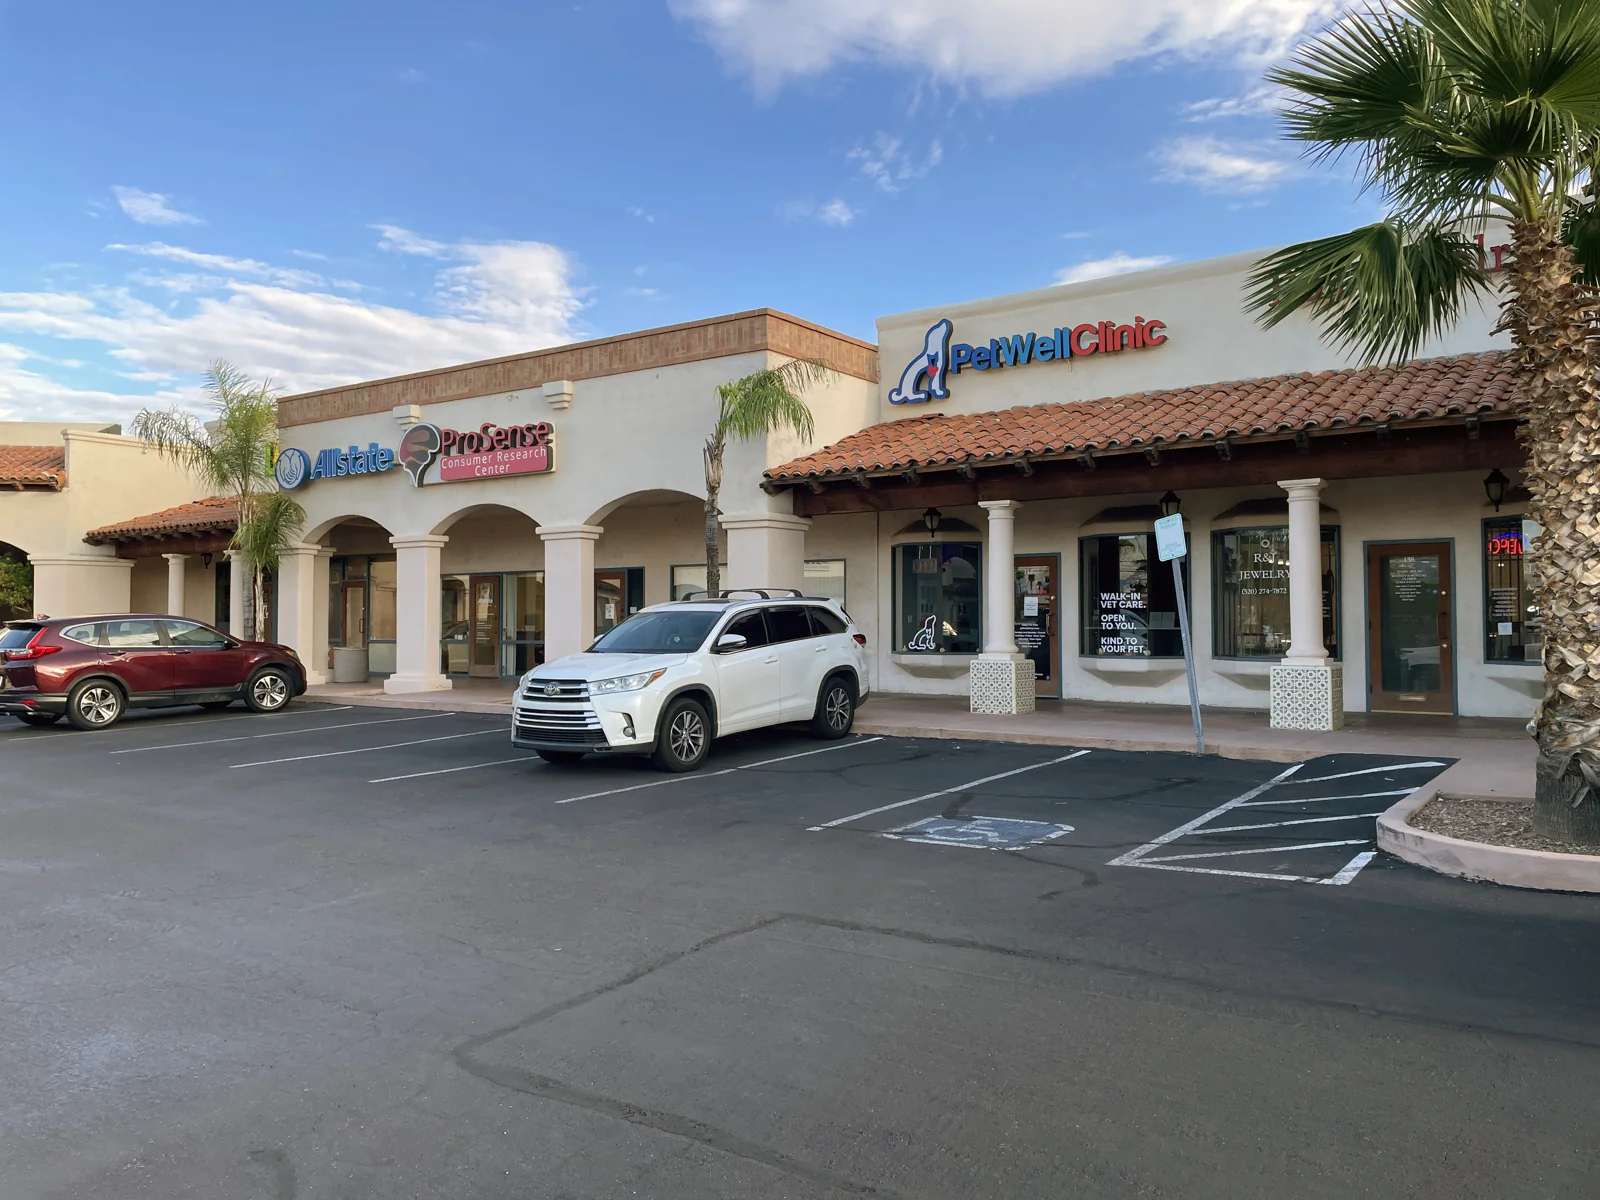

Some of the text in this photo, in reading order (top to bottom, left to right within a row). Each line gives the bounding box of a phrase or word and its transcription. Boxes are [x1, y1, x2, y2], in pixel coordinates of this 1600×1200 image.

[951, 316, 1168, 374] PetWellClinic
[441, 421, 552, 456] ProSense
[310, 443, 394, 479] Allstate
[441, 447, 547, 469] Consumer Research
[475, 463, 511, 477] Center
[1487, 538, 1523, 554] OPEN
[1253, 553, 1275, 563] R&J
[1239, 570, 1290, 580] JEWELRY
[1100, 592, 1141, 600] WALK-IN
[1100, 600, 1146, 608] VET CARE.
[1100, 614, 1125, 622] OPEN
[1100, 622, 1137, 630] TO YOU.
[1100, 636, 1138, 645] KIND TO
[1100, 644, 1146, 653] YOUR PET.
